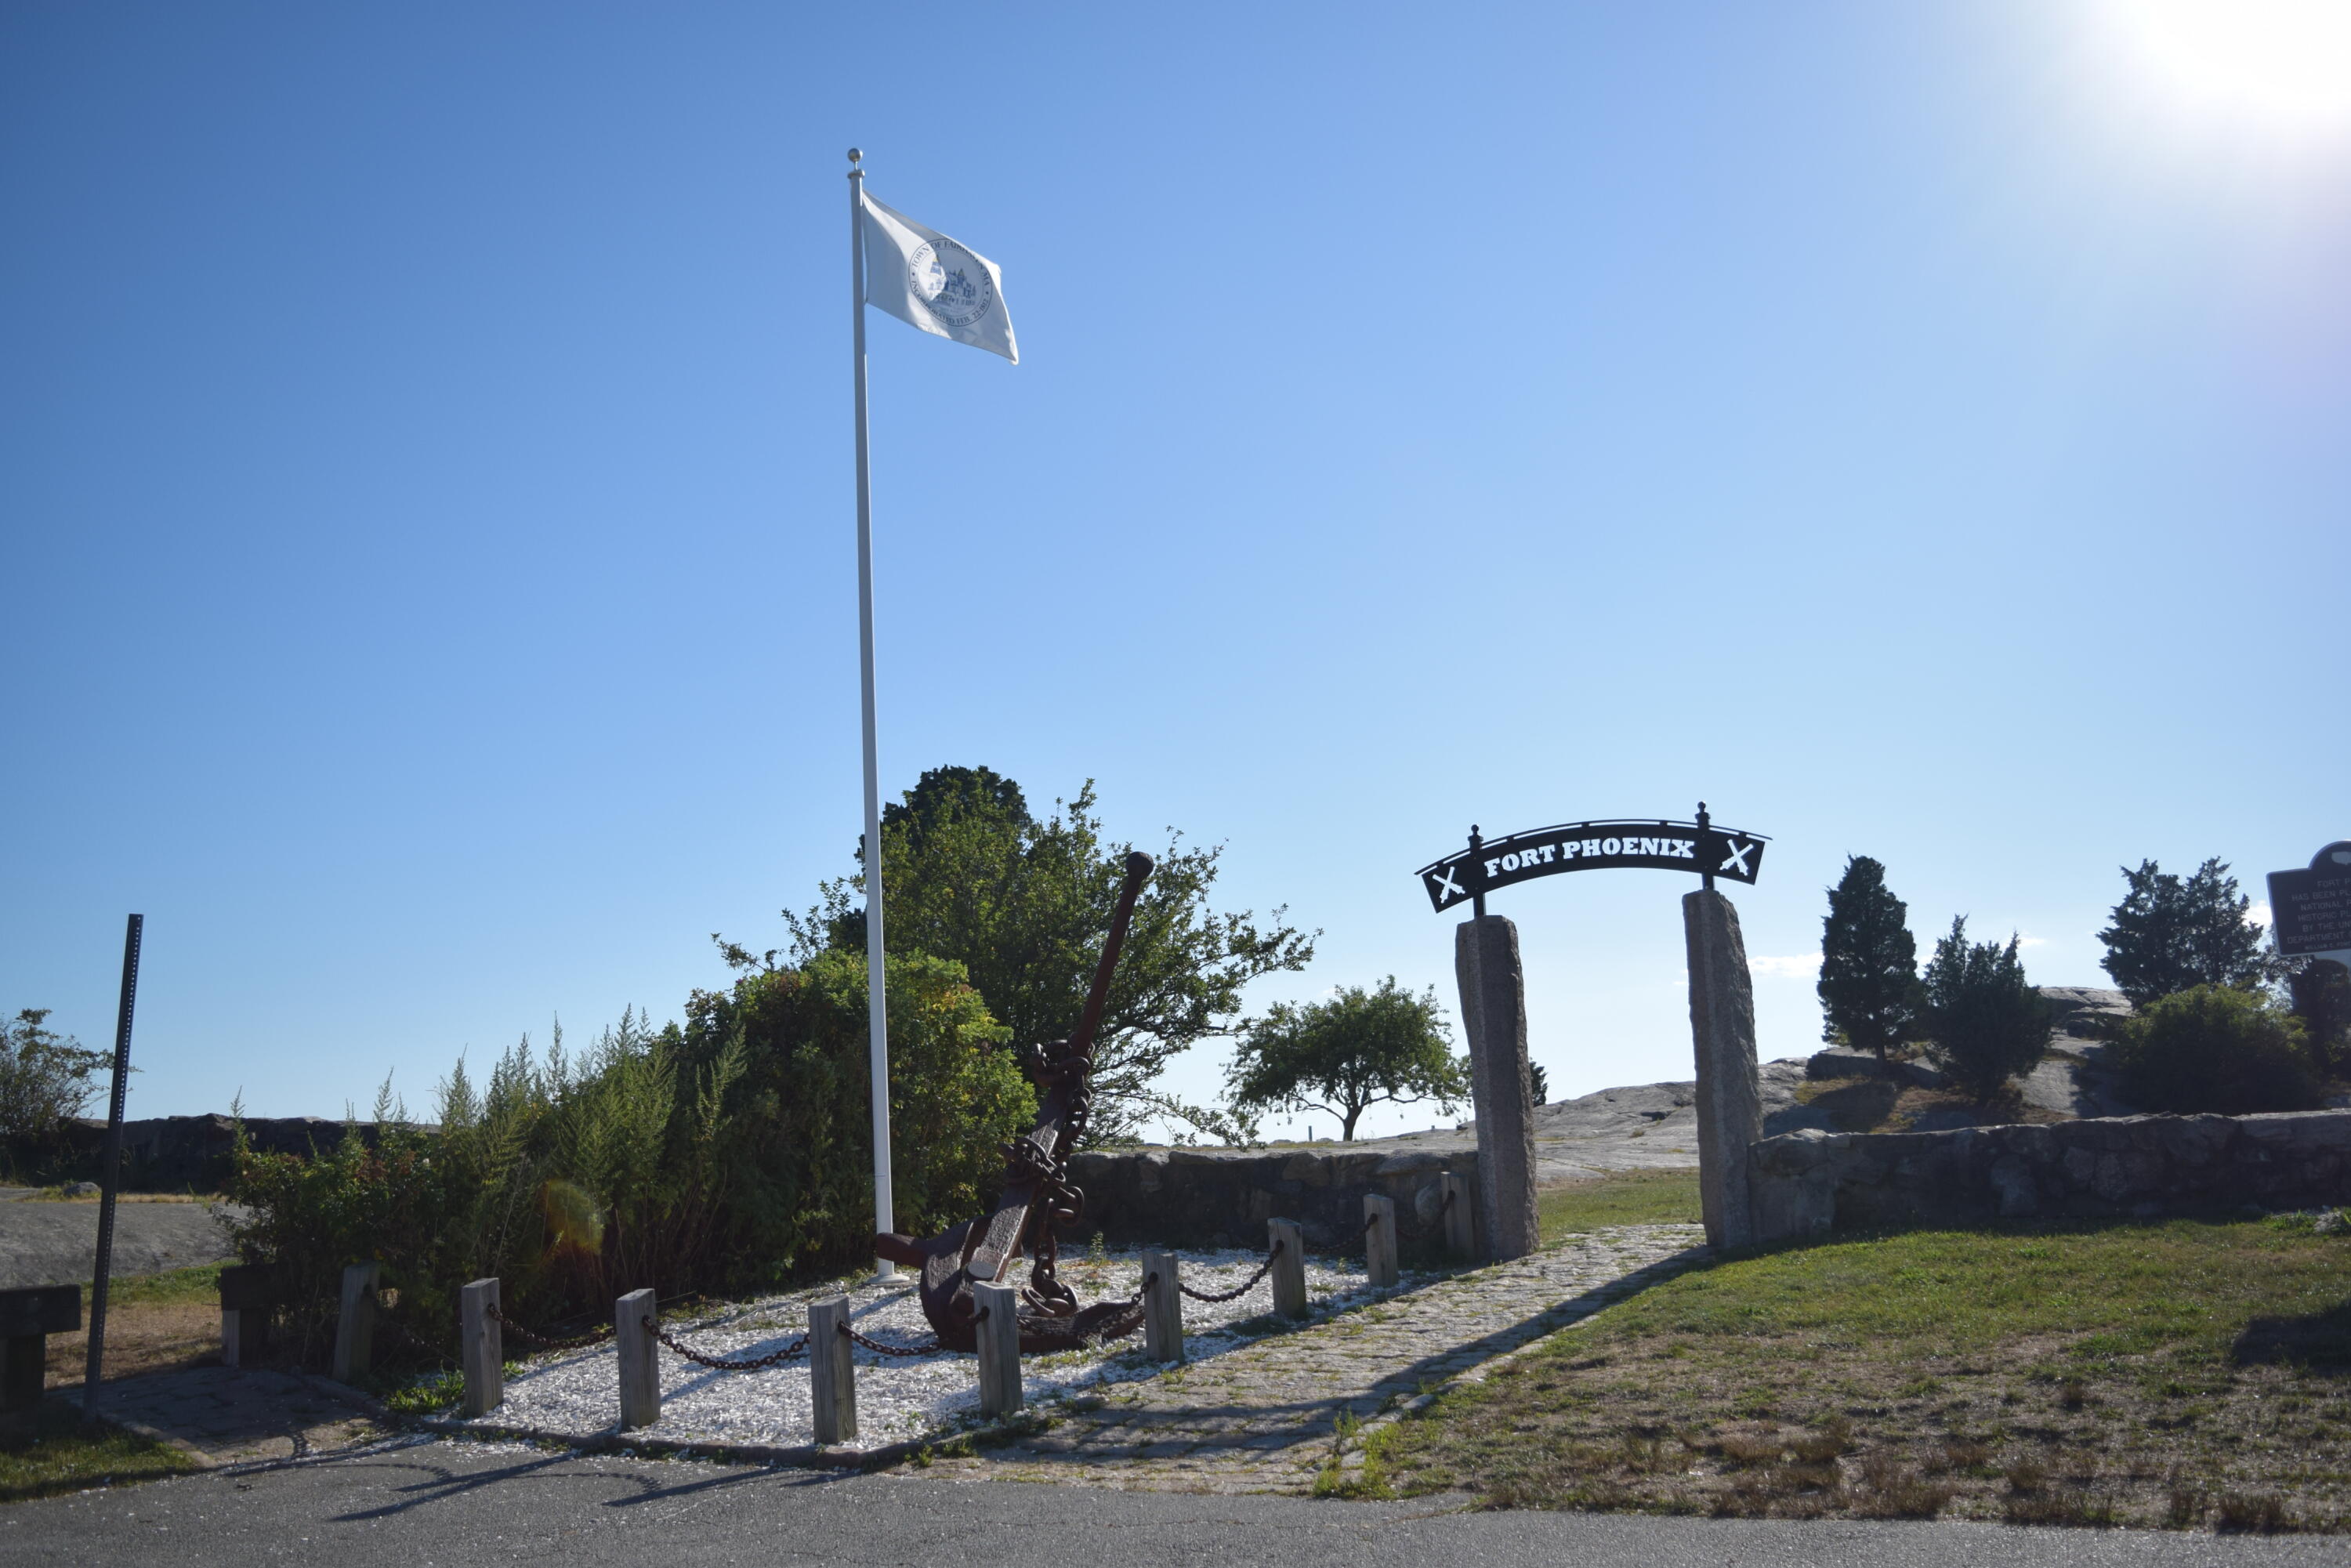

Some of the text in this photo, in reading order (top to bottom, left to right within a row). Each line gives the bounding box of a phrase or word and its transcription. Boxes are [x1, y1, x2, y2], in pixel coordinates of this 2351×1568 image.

[1483, 837, 1695, 878] FORT PHOENIX
[2317, 878, 2340, 888] FORT
[2291, 893, 2309, 902] HAS
[2313, 890, 2336, 900] BEEN
[2300, 901, 2344, 911] NATIONAL
[2298, 911, 2337, 922] HISTORIC
[2302, 923, 2313, 932] BY
[2317, 922, 2335, 931] THE
[2287, 932, 2345, 944] DEPARTMENT
